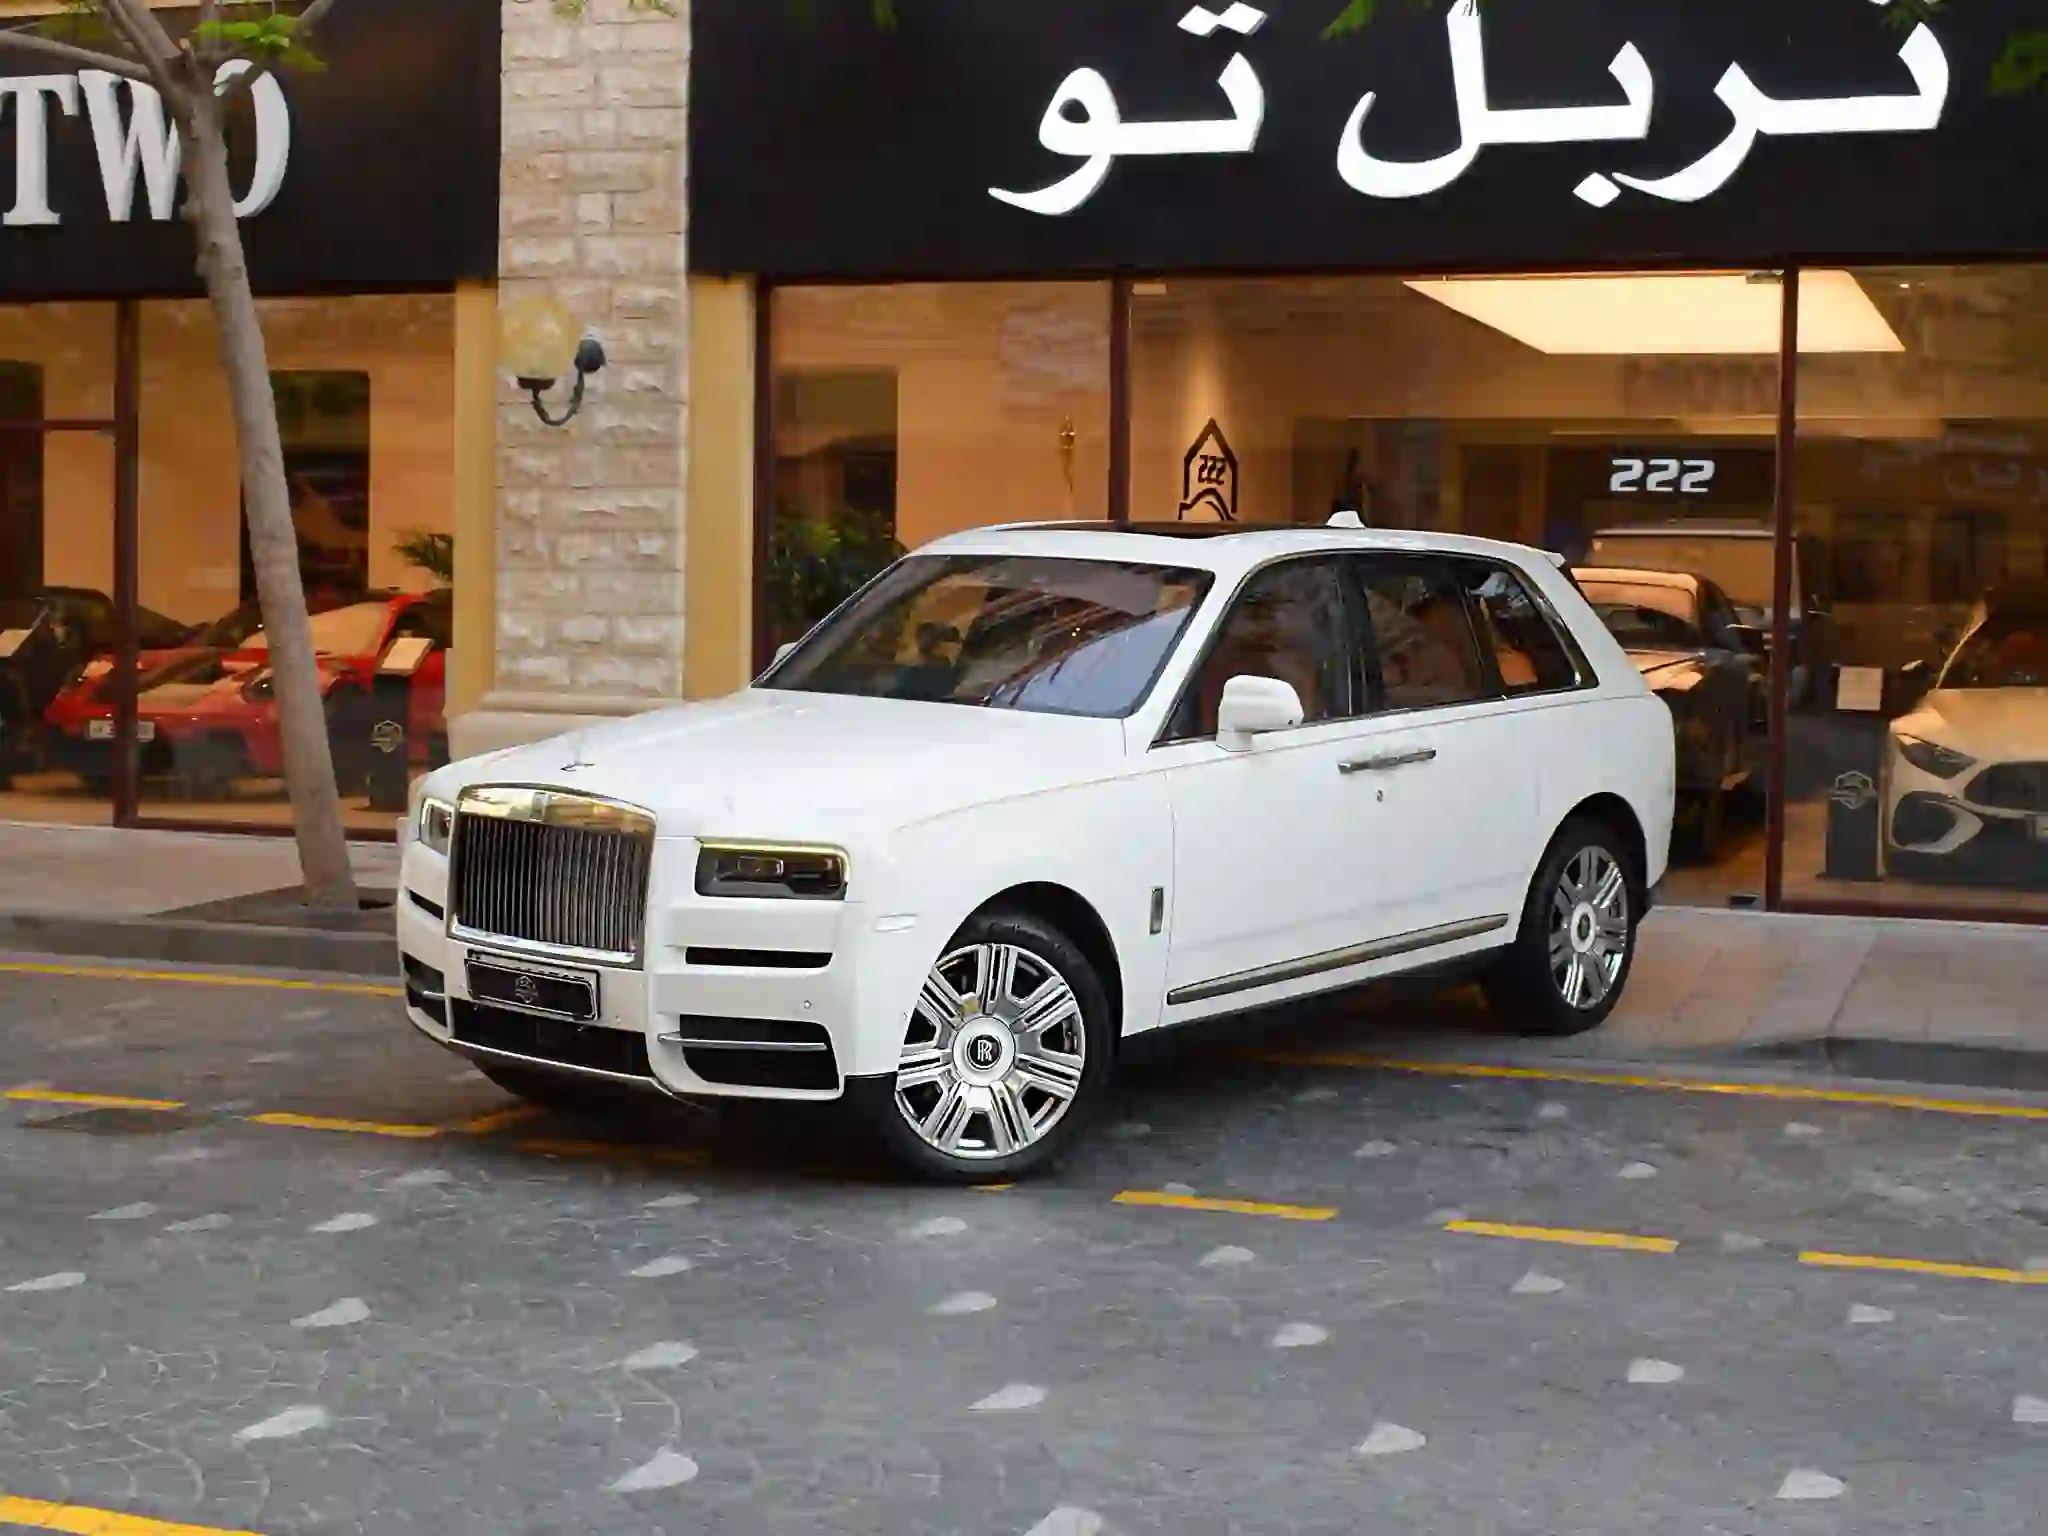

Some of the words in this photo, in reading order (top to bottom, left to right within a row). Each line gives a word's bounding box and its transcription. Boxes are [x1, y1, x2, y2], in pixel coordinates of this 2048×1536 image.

[0, 59, 290, 226] TWO
[987, 1, 1268, 216] تو
[1609, 458, 1716, 493] 222
